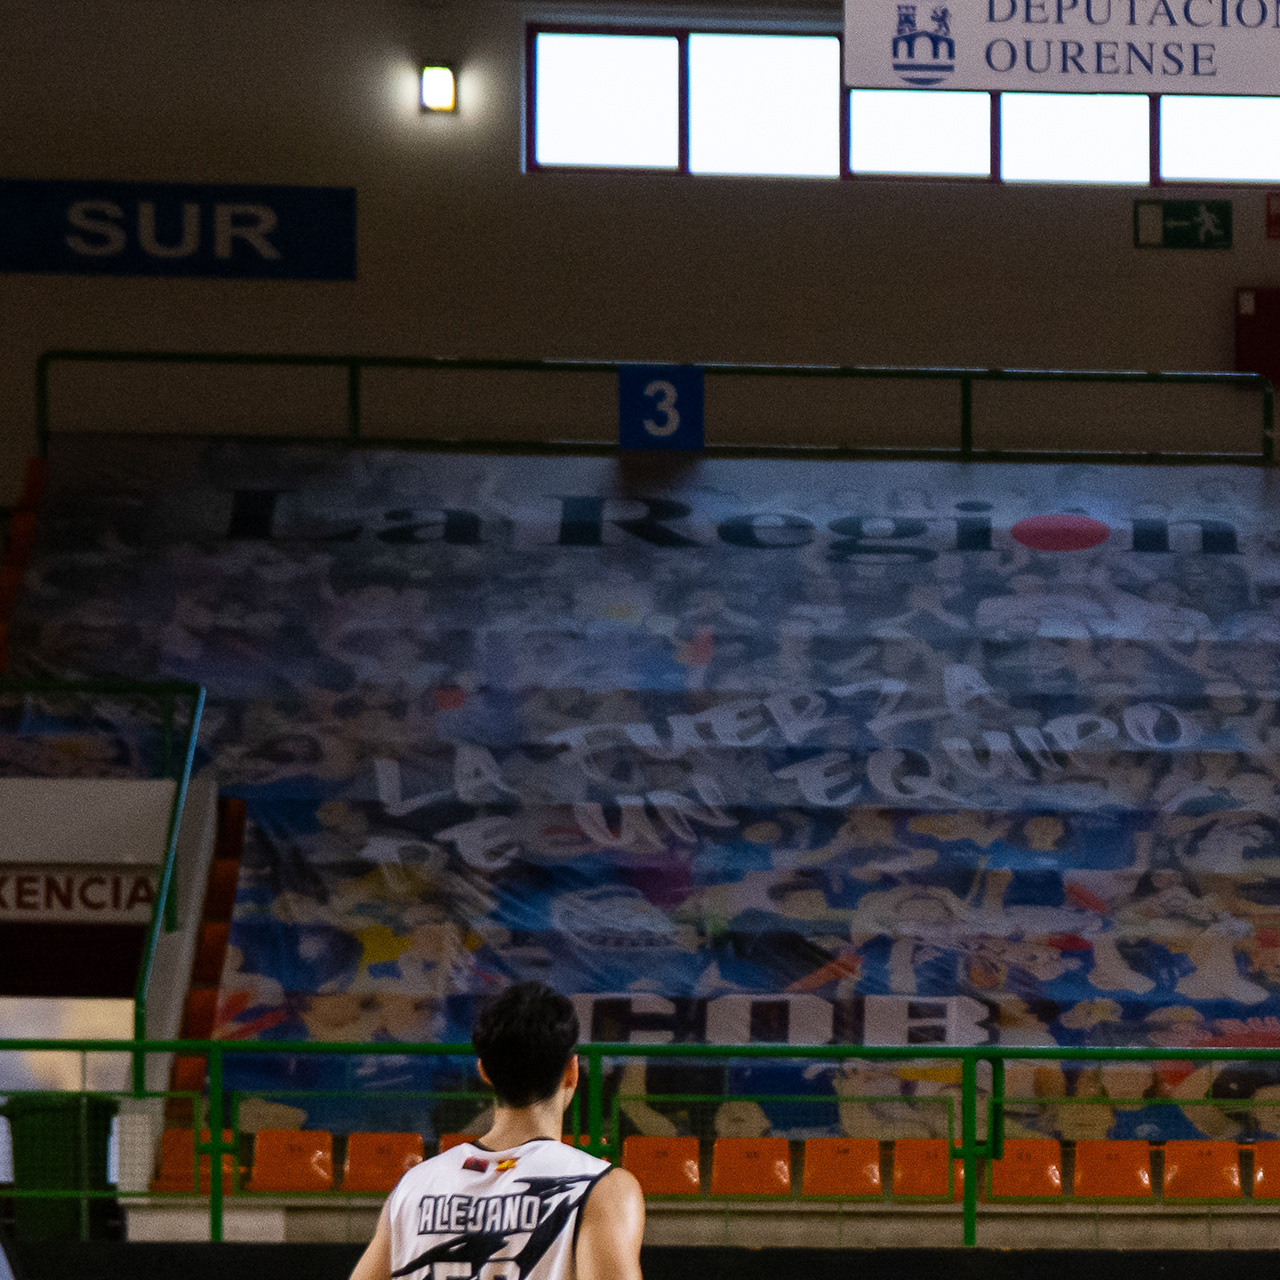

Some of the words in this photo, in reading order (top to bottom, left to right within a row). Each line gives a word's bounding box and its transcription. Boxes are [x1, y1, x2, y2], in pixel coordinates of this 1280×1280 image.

[985, 39, 1219, 77] OURENSE
[65, 201, 282, 260] SUR
[643, 380, 681, 437] 3
[0, 874, 154, 911] ENCIA
[417, 1194, 541, 1236] ALEJANO
